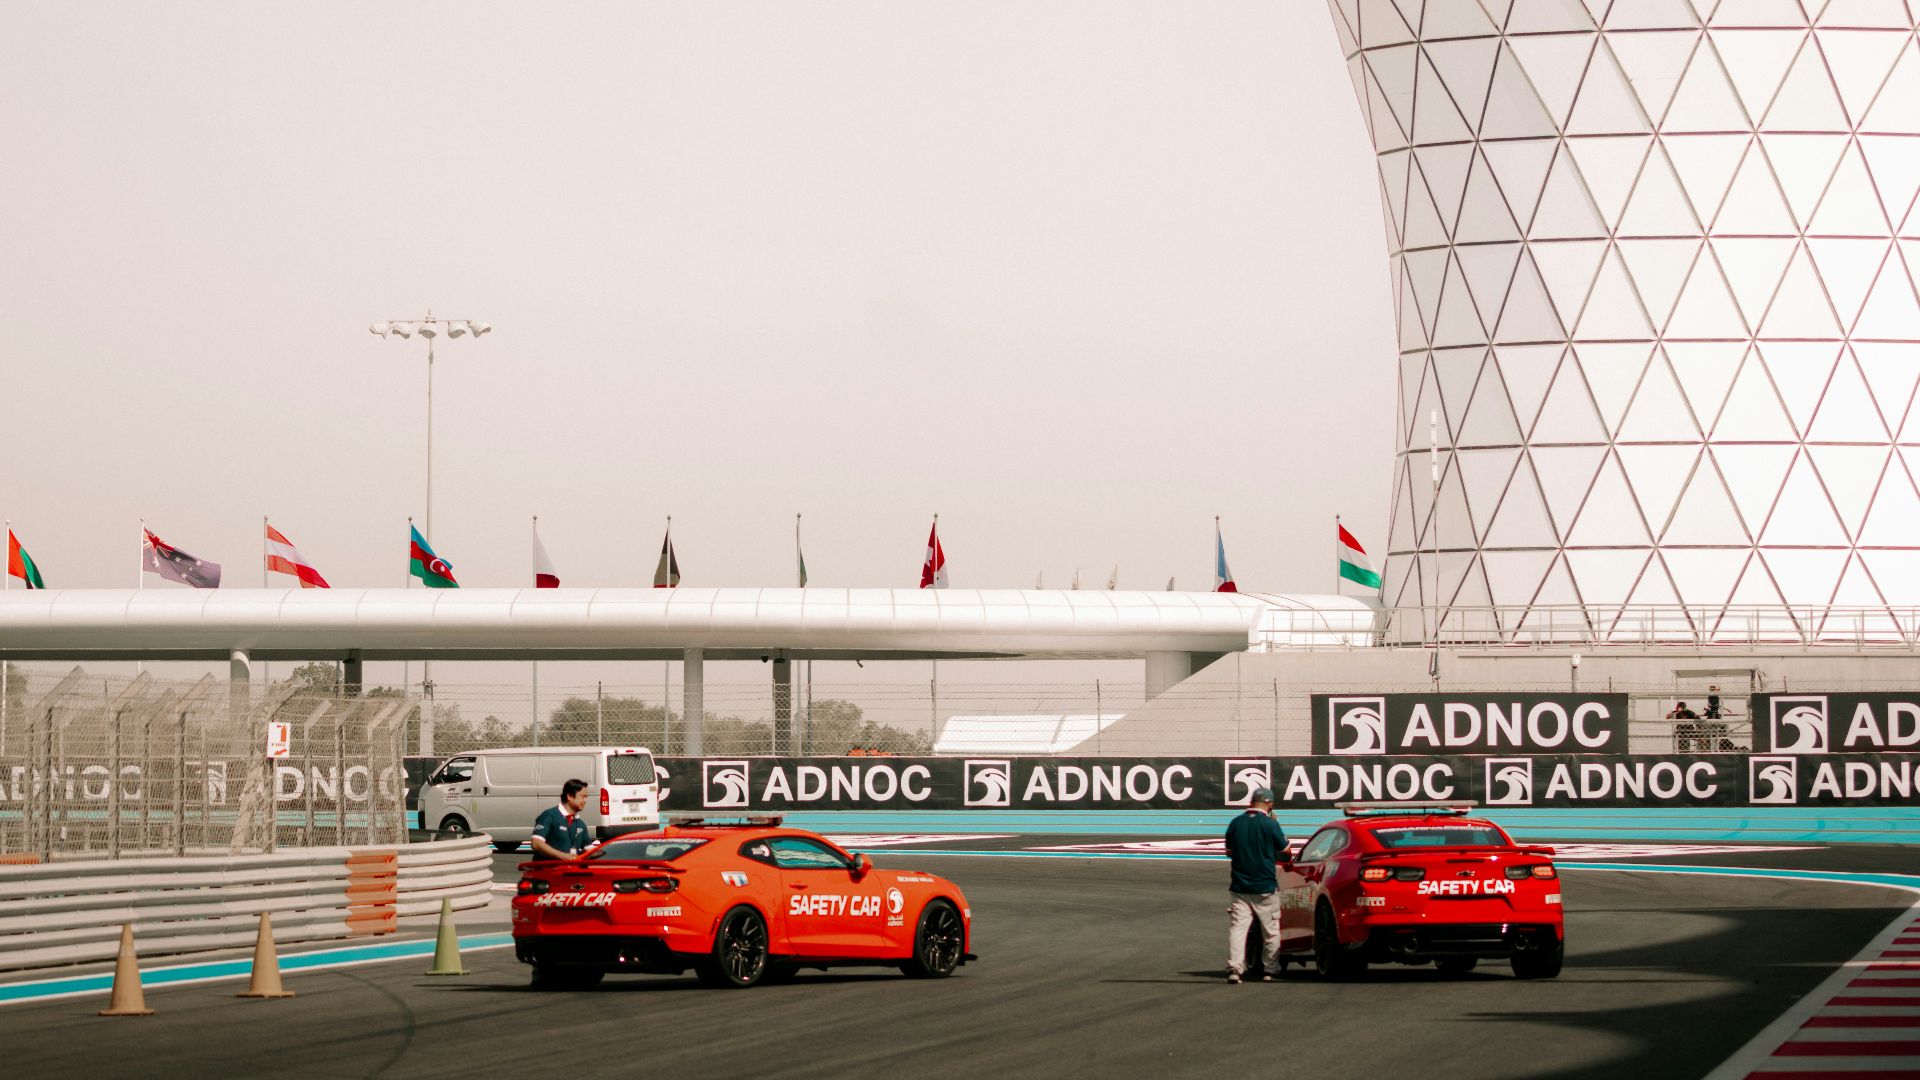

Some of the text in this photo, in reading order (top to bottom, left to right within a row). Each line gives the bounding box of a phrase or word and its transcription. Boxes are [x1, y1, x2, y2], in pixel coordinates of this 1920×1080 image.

[1401, 702, 1611, 747] ADNOC
[1843, 702, 1920, 746] AD
[761, 765, 932, 801] ADNOC
[1022, 765, 1193, 801] ADNOC
[1283, 764, 1454, 800] ADNOC
[1545, 762, 1717, 799] ADNOC
[1809, 762, 1920, 798] ADN
[534, 892, 617, 907] SAFETY CAR
[1417, 879, 1515, 895] SAFETY CAR
[789, 895, 881, 916] SAFETY CAR
